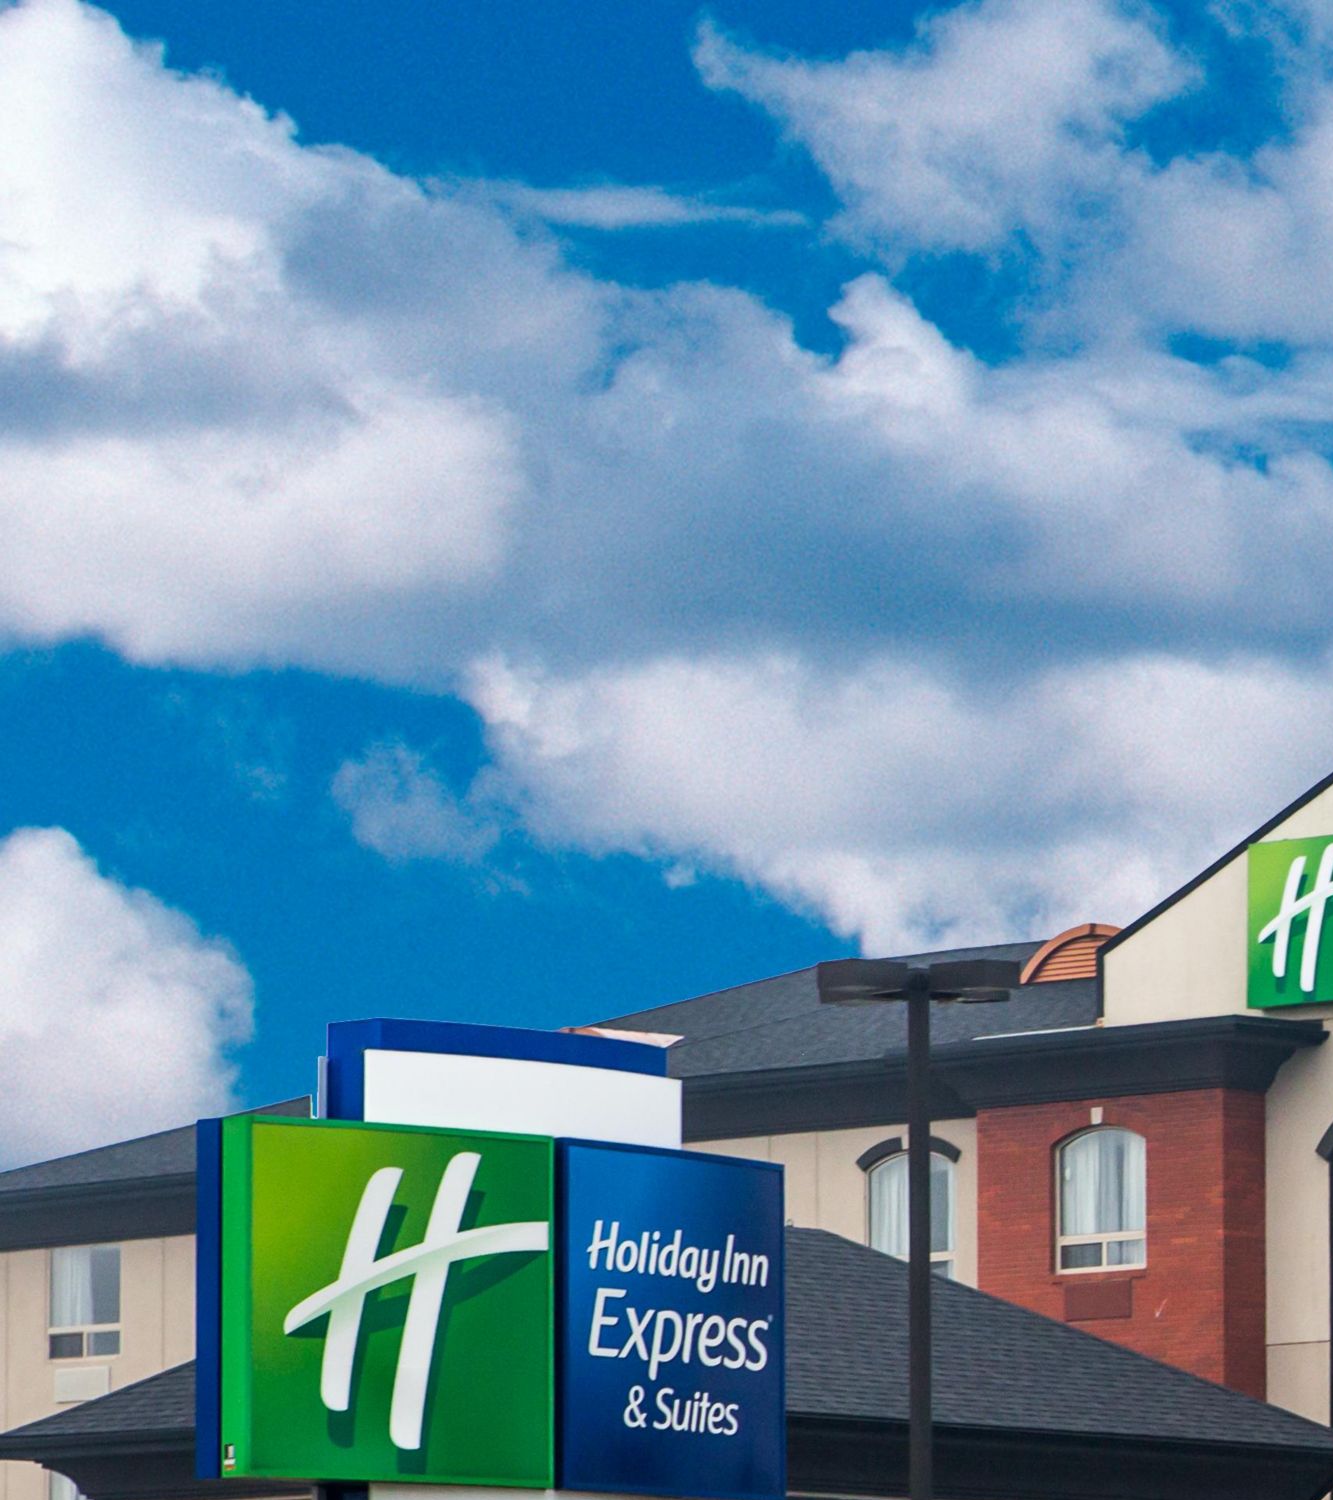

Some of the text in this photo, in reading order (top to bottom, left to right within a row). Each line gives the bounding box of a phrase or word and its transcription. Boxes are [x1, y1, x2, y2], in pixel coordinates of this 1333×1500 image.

[586, 1220, 769, 1293] Holiday Inn
[588, 1287, 770, 1381] Express
[623, 1385, 739, 1436] & Suites
